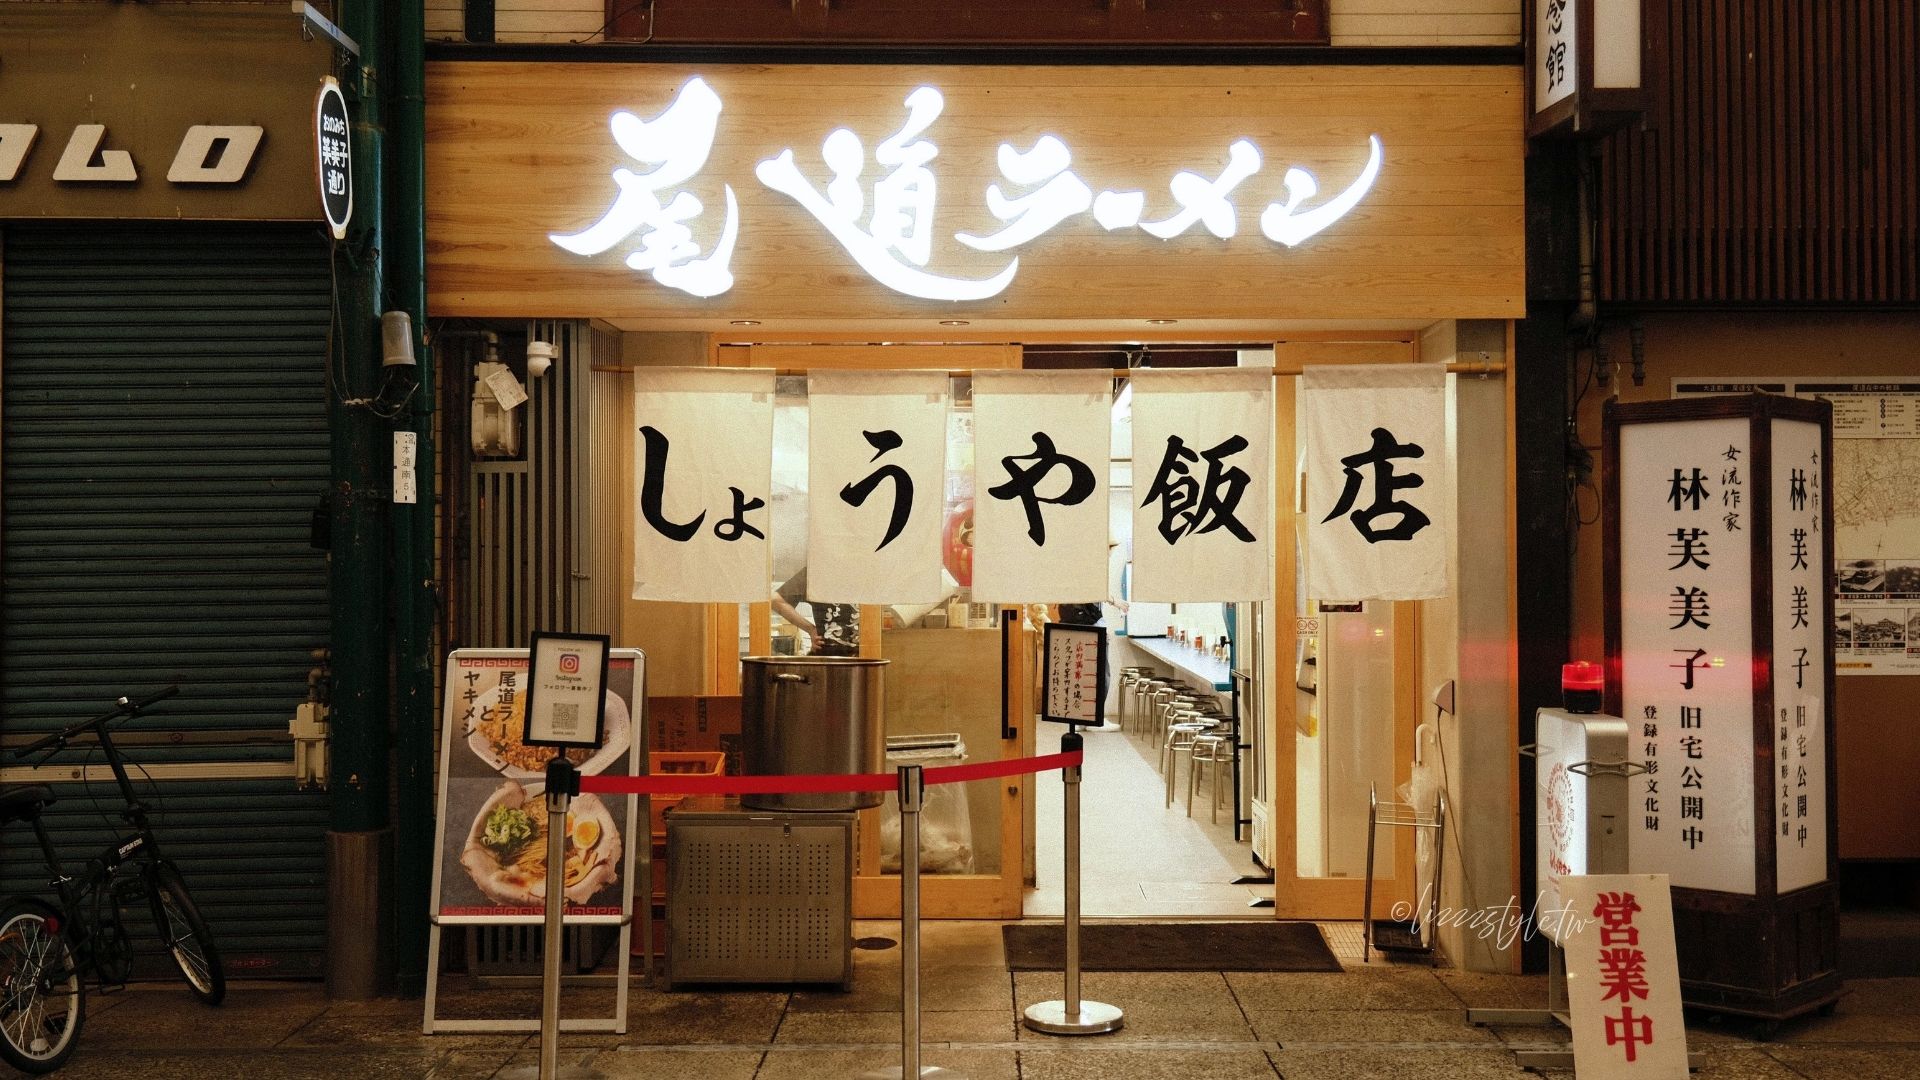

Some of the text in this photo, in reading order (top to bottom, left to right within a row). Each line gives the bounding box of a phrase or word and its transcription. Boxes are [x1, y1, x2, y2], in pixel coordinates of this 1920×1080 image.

[322, 136, 348, 170] 芙美子
[323, 114, 345, 136] おのみち
[327, 169, 346, 196] 通り
[548, 76, 1383, 302] 尾道ラーメン
[637, 425, 1431, 552] しょうや飯店
[1721, 444, 1742, 533] 女流作家
[1667, 467, 1711, 690] 林芙美子
[1789, 468, 1810, 689] 林芙美子
[461, 671, 480, 739] ヤキメシ
[480, 706, 494, 722] と
[494, 671, 516, 773] 尾道ラーメン
[1643, 705, 1660, 832] 登録有形文化財
[1679, 705, 1704, 851] 旧宅公開中
[1780, 708, 1790, 837] 登録有形文化財
[1795, 705, 1808, 849] 旧宅公開中
[1593, 891, 1654, 1063] 営業中
